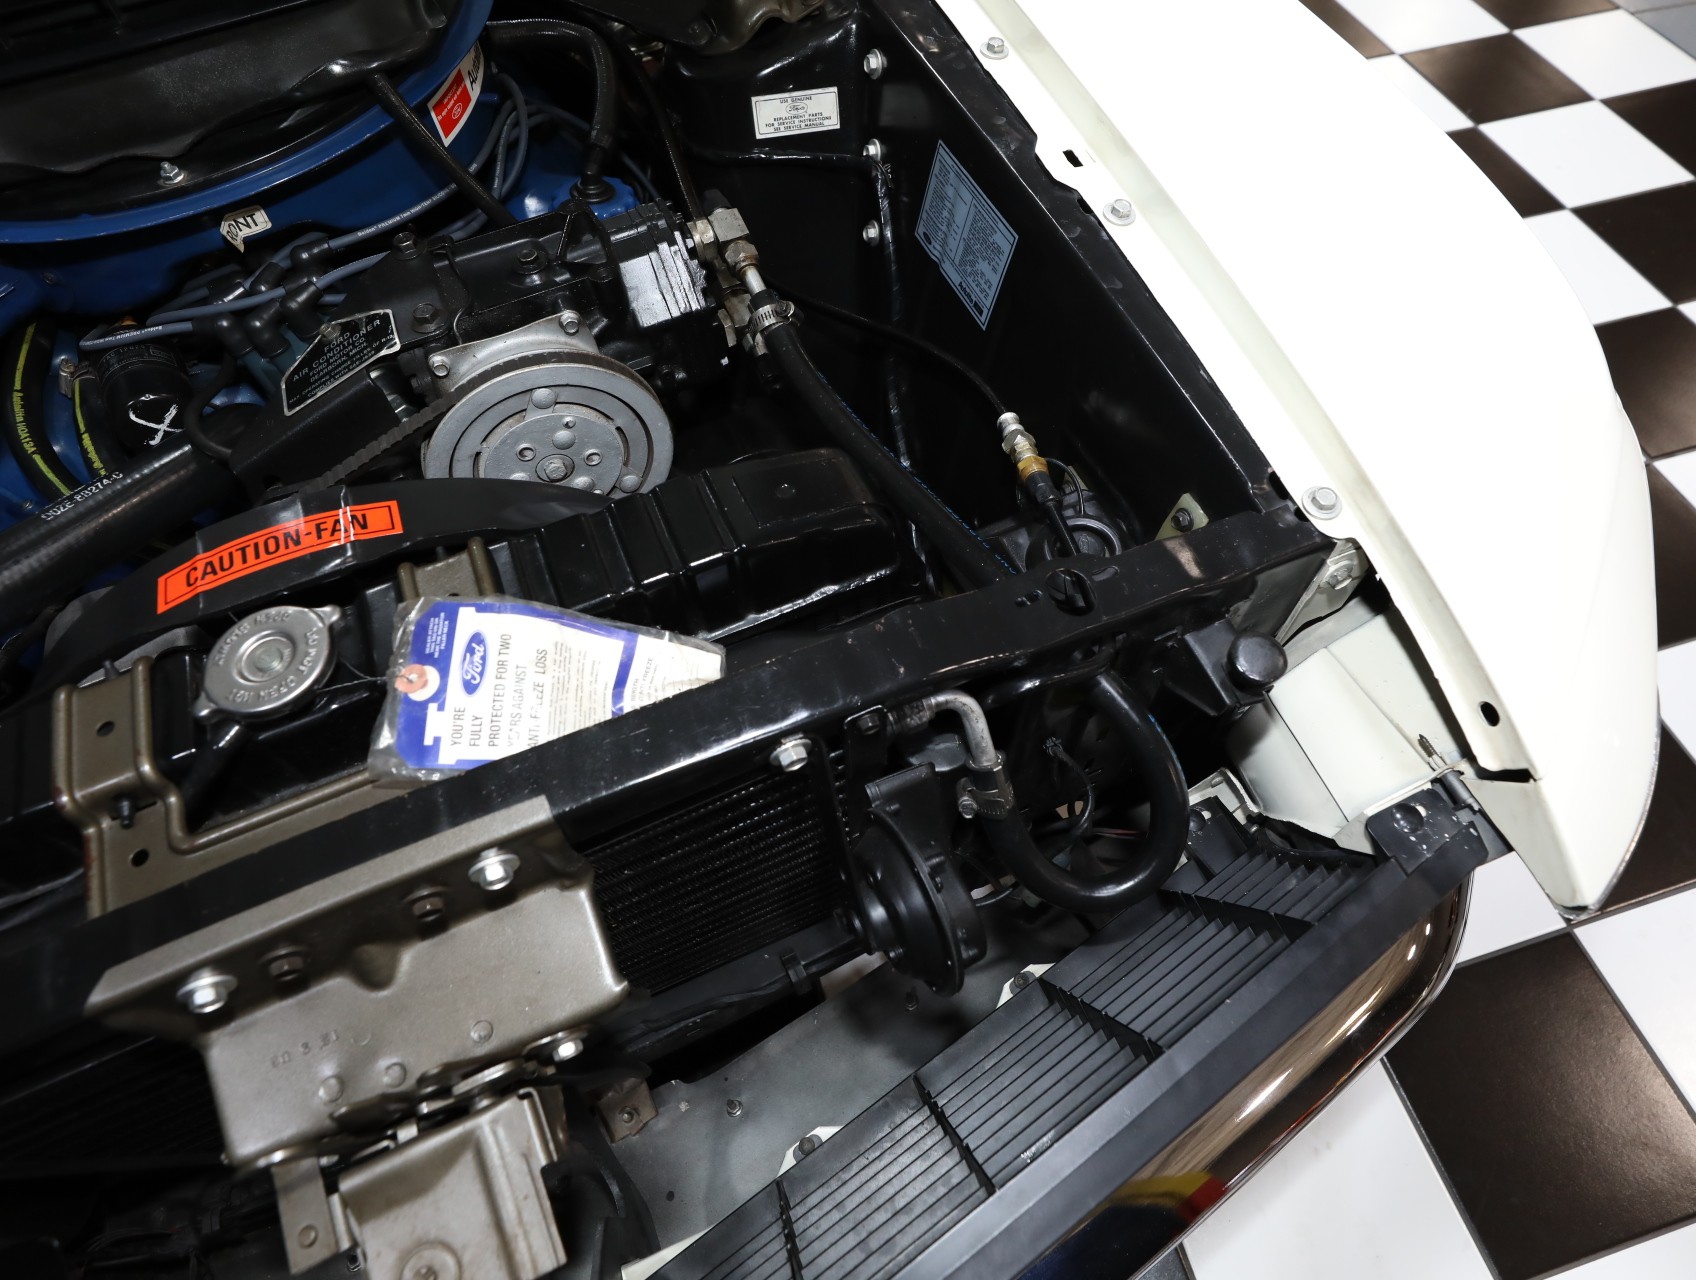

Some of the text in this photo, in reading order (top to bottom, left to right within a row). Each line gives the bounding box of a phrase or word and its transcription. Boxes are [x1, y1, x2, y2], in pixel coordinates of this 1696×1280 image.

[774, 114, 806, 122] REPLACEMENT
[293, 319, 380, 381] AIR CONDITIONER
[309, 362, 327, 376] FORD
[330, 346, 353, 363] MOTOR
[324, 332, 350, 353] FORD
[185, 513, 369, 588] CAUTION-FAN
[462, 642, 485, 685] Ford
[535, 649, 548, 675] LOSS
[488, 634, 512, 747] PROTECTED FOR TWO
[512, 664, 527, 710] AGAINST
[450, 706, 466, 746] YOU'RE
[469, 715, 483, 747] FULLY
